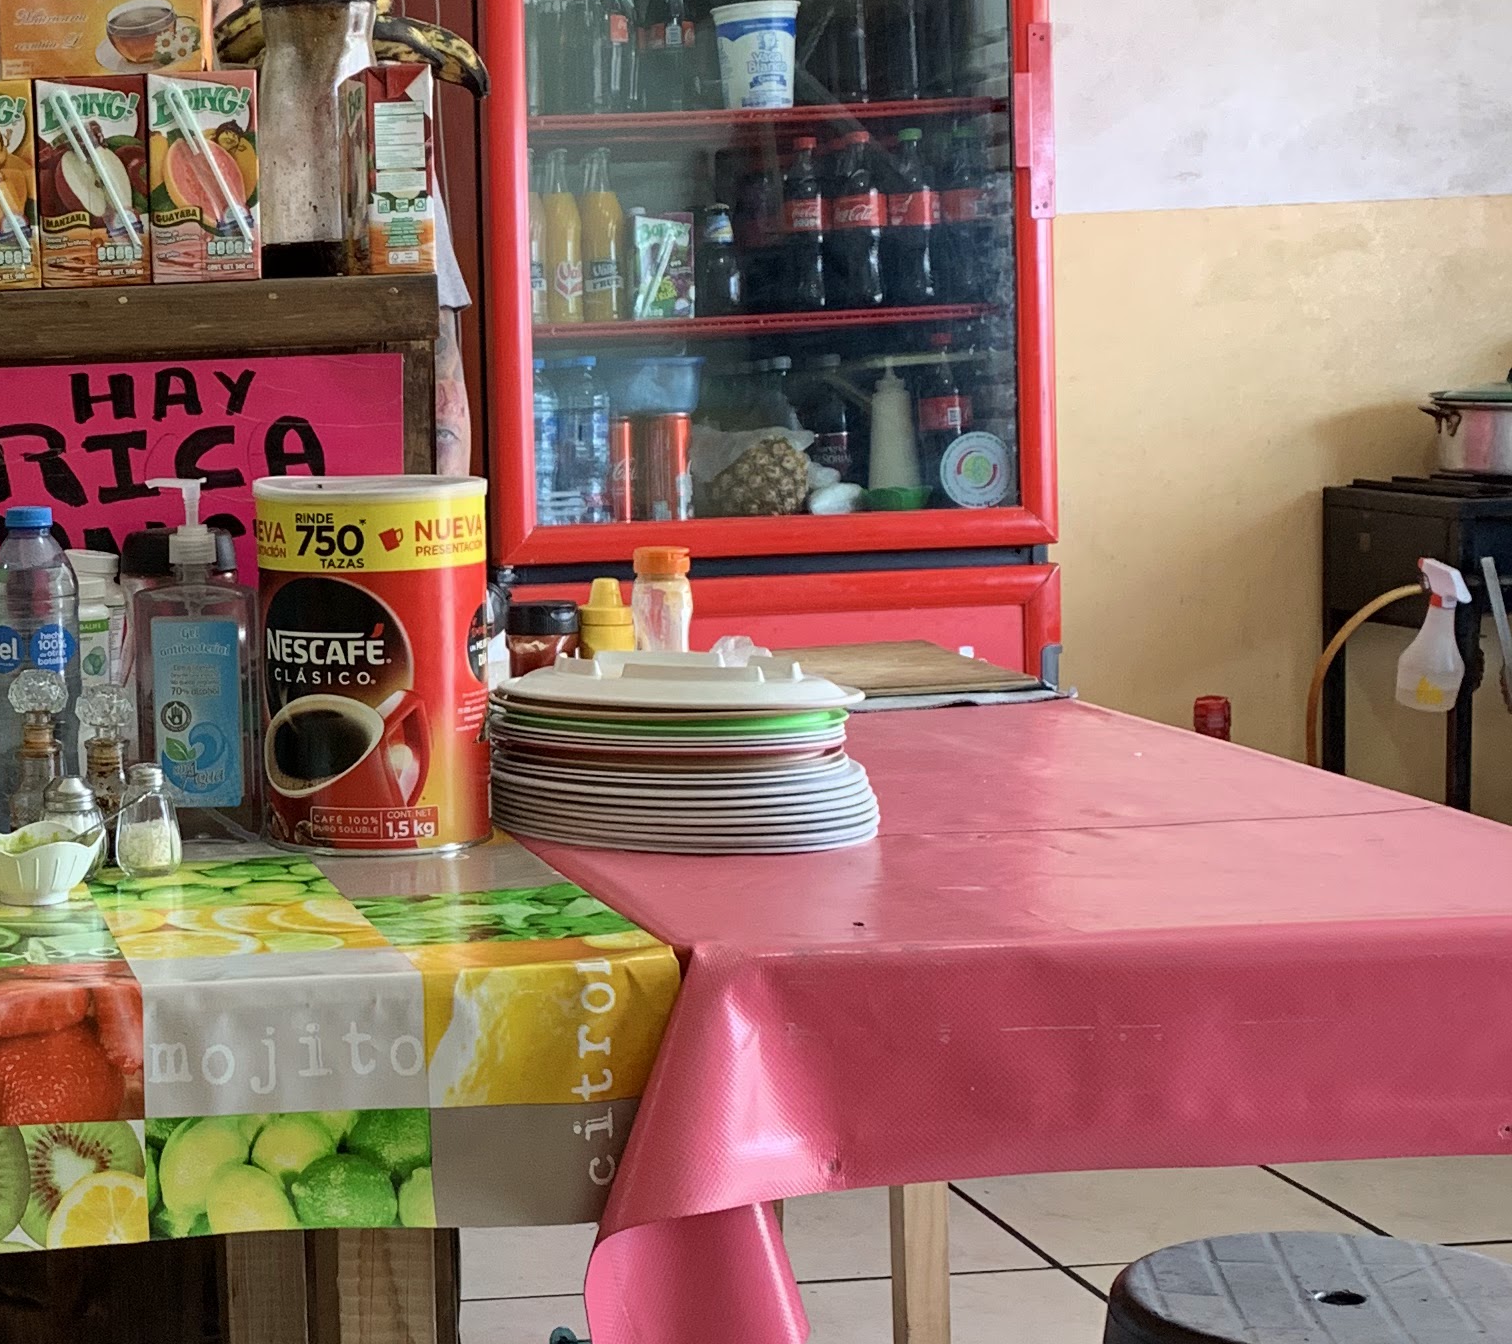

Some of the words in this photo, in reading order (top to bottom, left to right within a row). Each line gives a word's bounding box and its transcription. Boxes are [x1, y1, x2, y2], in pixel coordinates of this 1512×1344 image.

[45, 214, 87, 229] MANZANA
[156, 209, 197, 223] GUAYABA
[70, 367, 256, 423] HAY
[295, 512, 334, 525] RINDE
[415, 513, 483, 543] NUEVA
[320, 558, 365, 569] TAZAS
[37, 639, 67, 651] 100%
[160, 642, 231, 657] antibacterial
[266, 623, 385, 666] NESCAFÉ
[275, 667, 370, 685] CLÁSICO
[313, 814, 343, 825] CAFÉ
[348, 815, 379, 825] 100%
[339, 825, 379, 835] SOLUBLE
[386, 821, 409, 839] 1,5
[413, 819, 435, 838] kg
[147, 1024, 426, 1097] mojito
